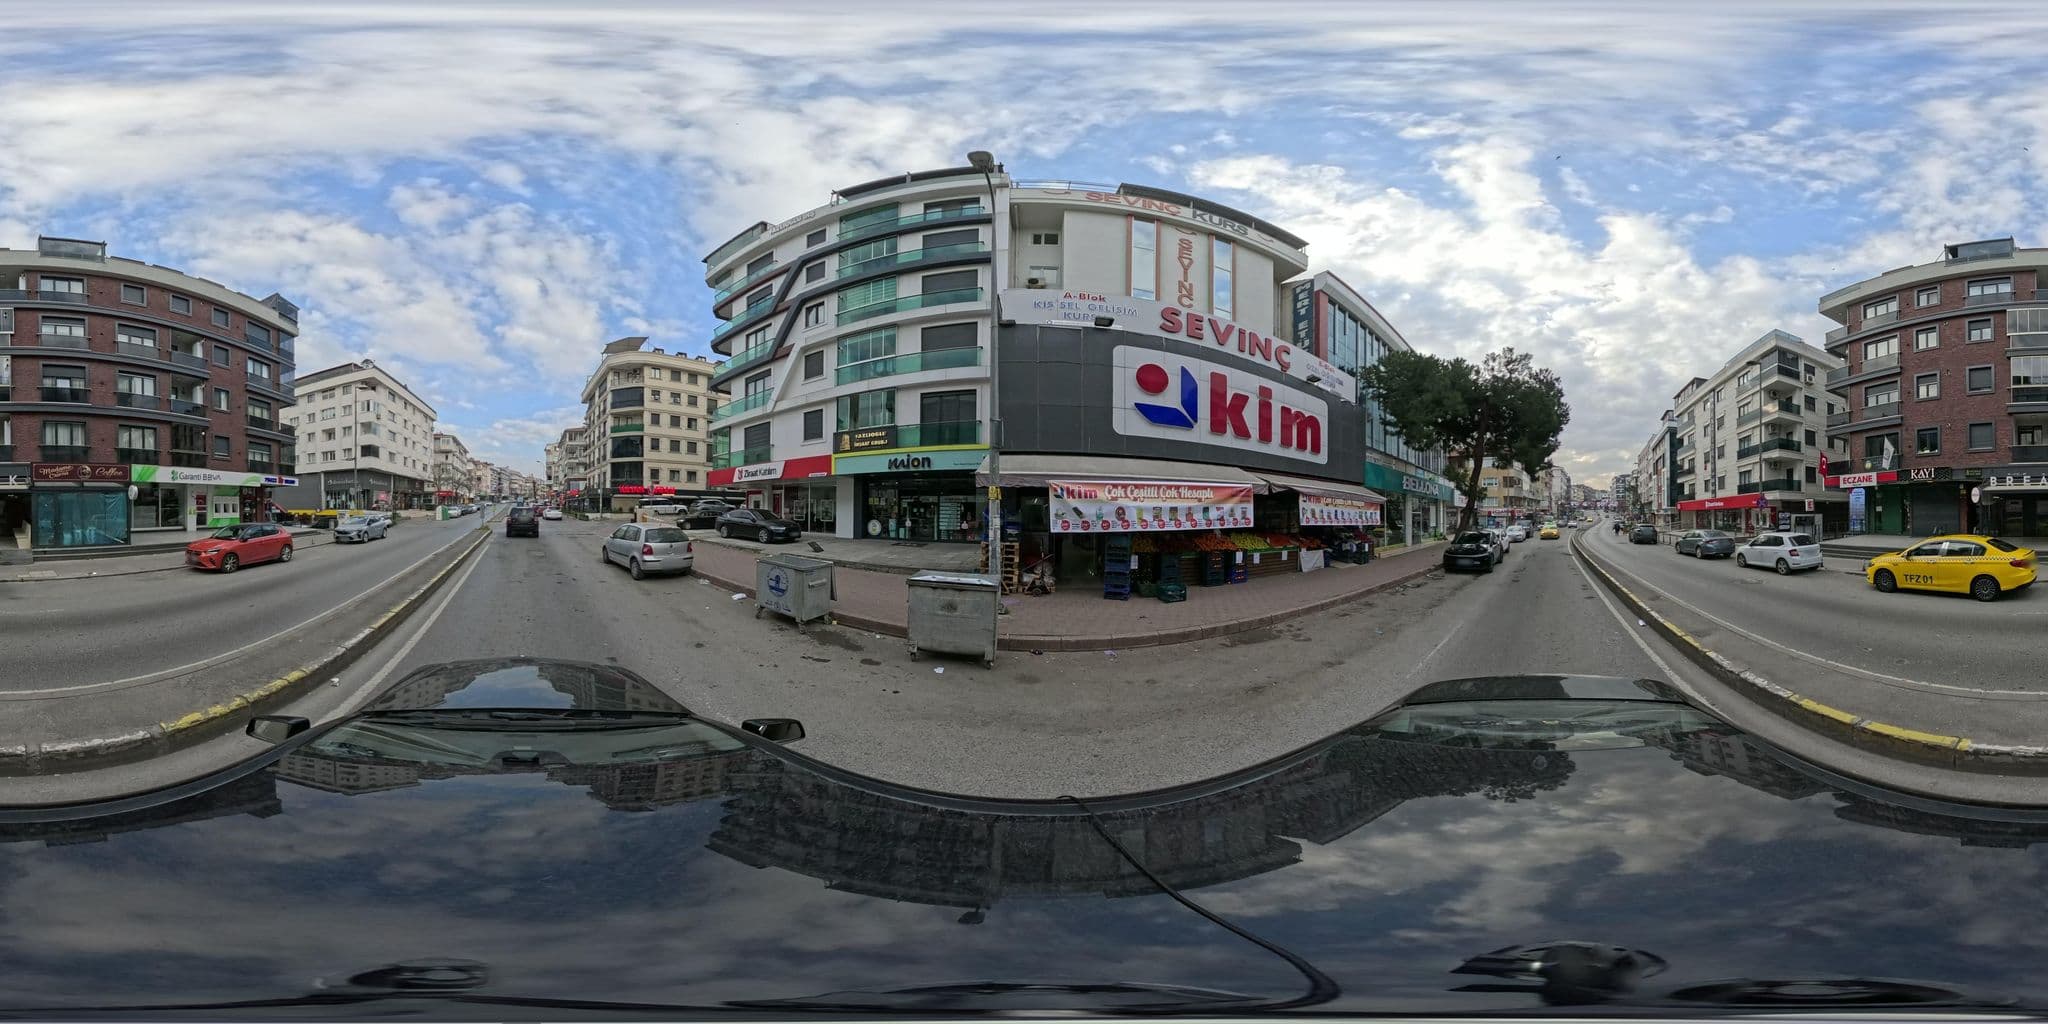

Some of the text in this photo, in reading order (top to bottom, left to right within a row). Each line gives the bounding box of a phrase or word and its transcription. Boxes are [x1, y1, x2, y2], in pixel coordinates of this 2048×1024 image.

[1192, 208, 1249, 236] KURS
[1063, 291, 1106, 303] A-Blok
[1159, 306, 1291, 372] SEVİNÇ
[1208, 371, 1321, 455] kim
[179, 471, 202, 481] Garanti
[743, 469, 759, 478] Ziraat
[1842, 474, 1874, 485] ECZANE
[1910, 467, 1935, 480] KAYI
[8, 474, 18, 486] K
[1402, 475, 1440, 497] BELLONA
[1065, 484, 1214, 502] kim Çok Çeşitli Çok Hesaplı
[1904, 574, 1933, 584] TFZ 01
